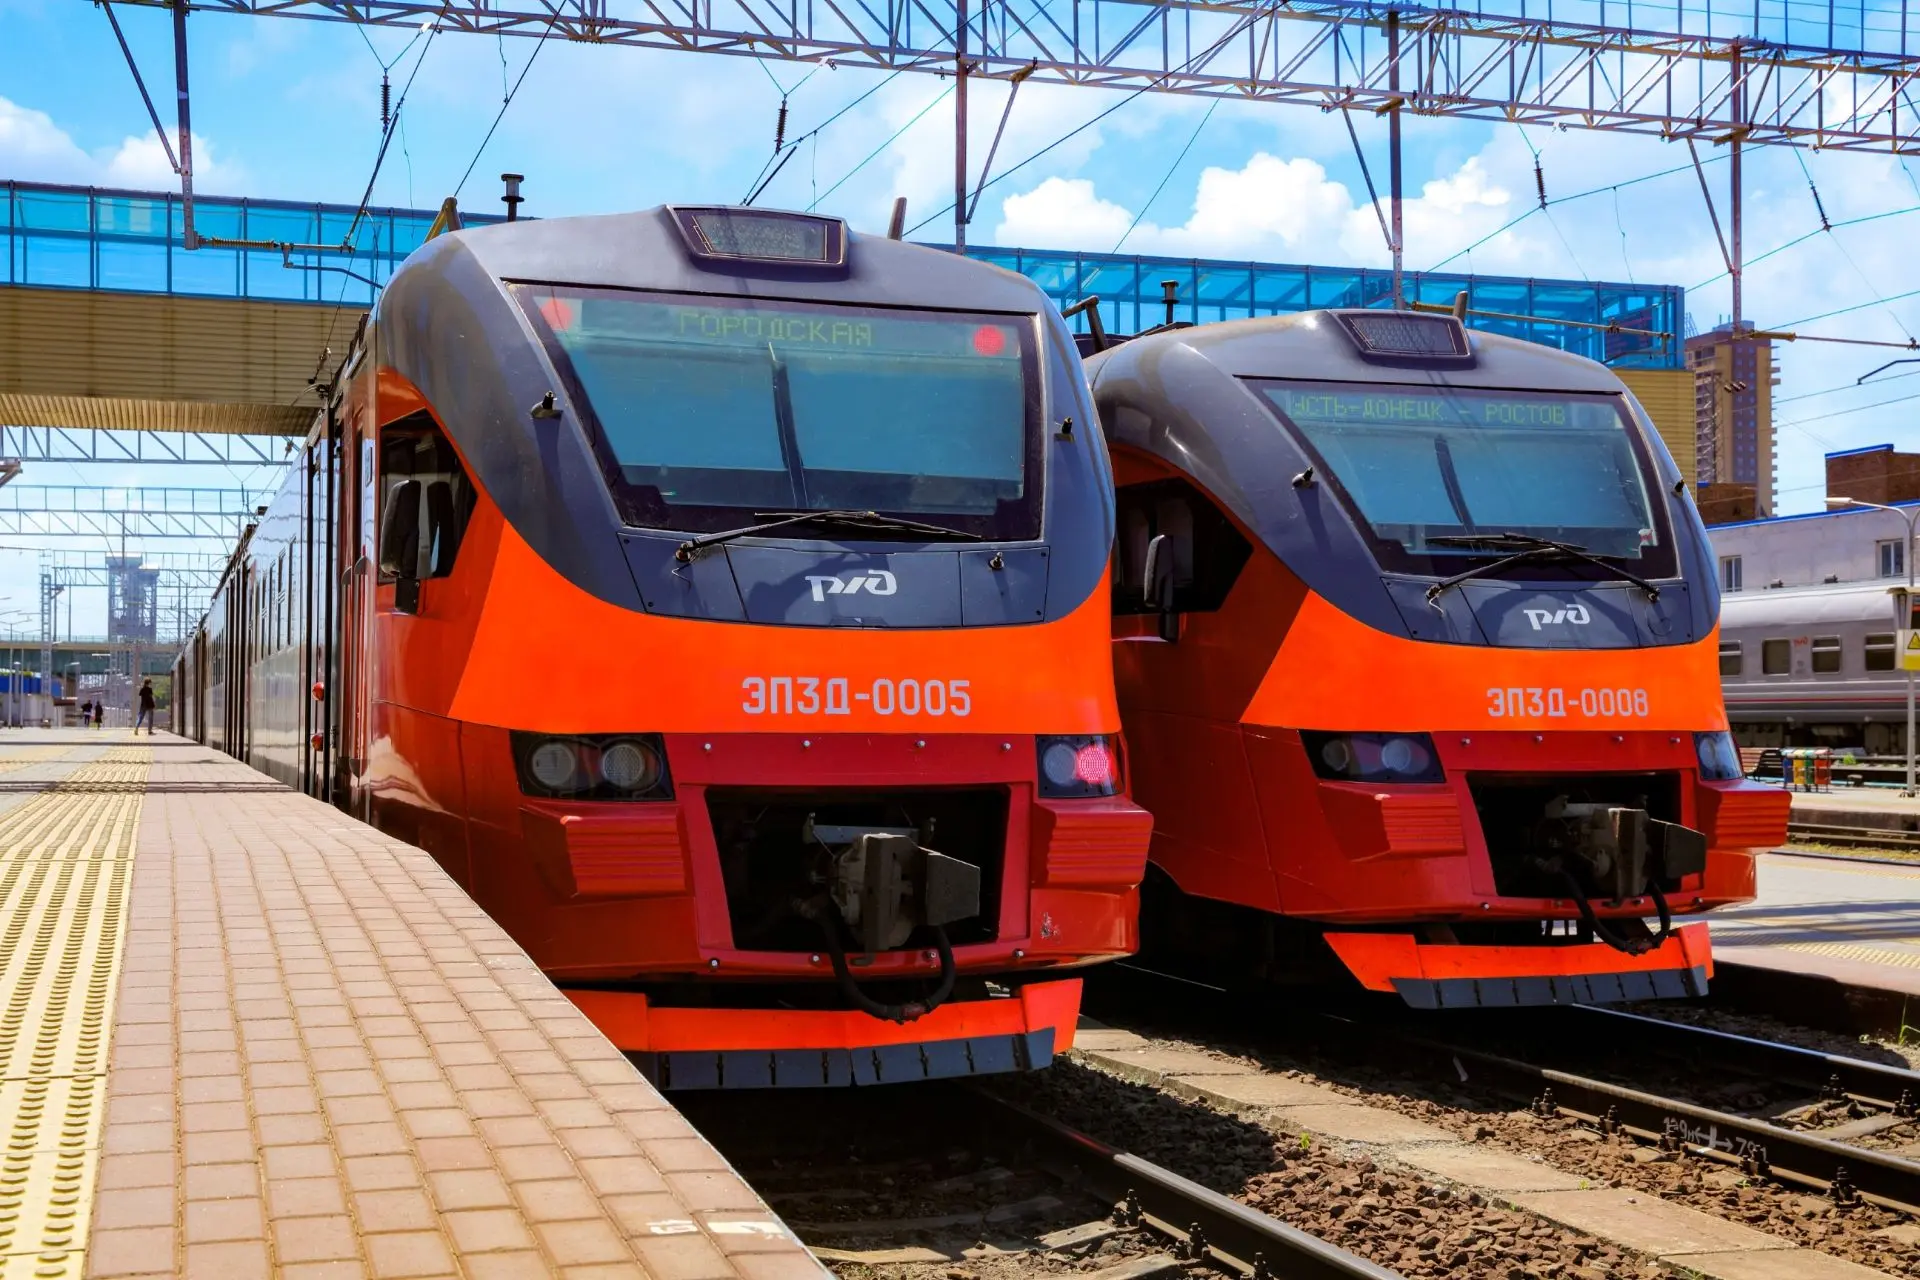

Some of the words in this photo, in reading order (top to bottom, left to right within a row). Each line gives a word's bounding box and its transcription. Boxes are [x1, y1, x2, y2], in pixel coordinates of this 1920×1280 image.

[678, 310, 872, 346] ГОРОДСКАЯ
[1486, 403, 1567, 425] РОСТОВ
[742, 676, 971, 717] ЭП3Д-0005
[1486, 687, 1650, 718] ЭП3Д-0008
